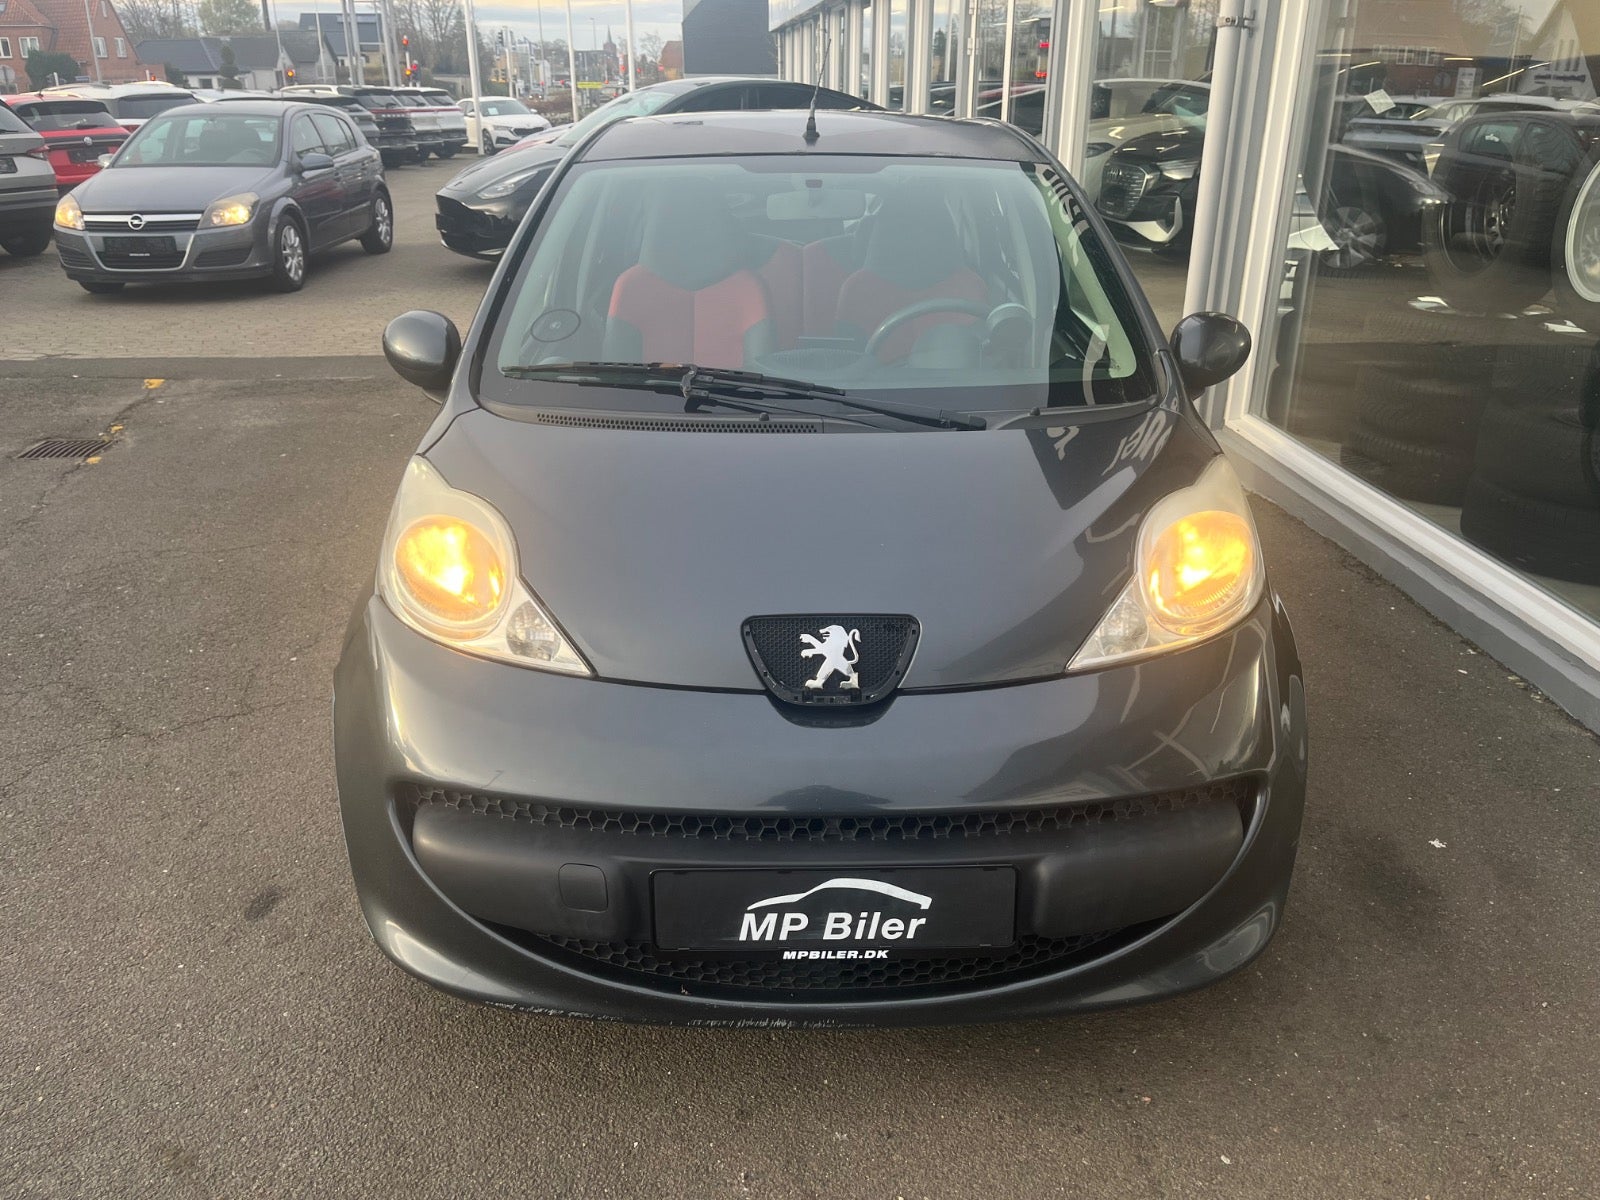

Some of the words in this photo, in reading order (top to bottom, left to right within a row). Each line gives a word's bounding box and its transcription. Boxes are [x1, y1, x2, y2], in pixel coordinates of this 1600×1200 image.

[738, 912, 809, 941] MP
[822, 911, 927, 940] Biler
[782, 950, 889, 960] MPBILER.DK
